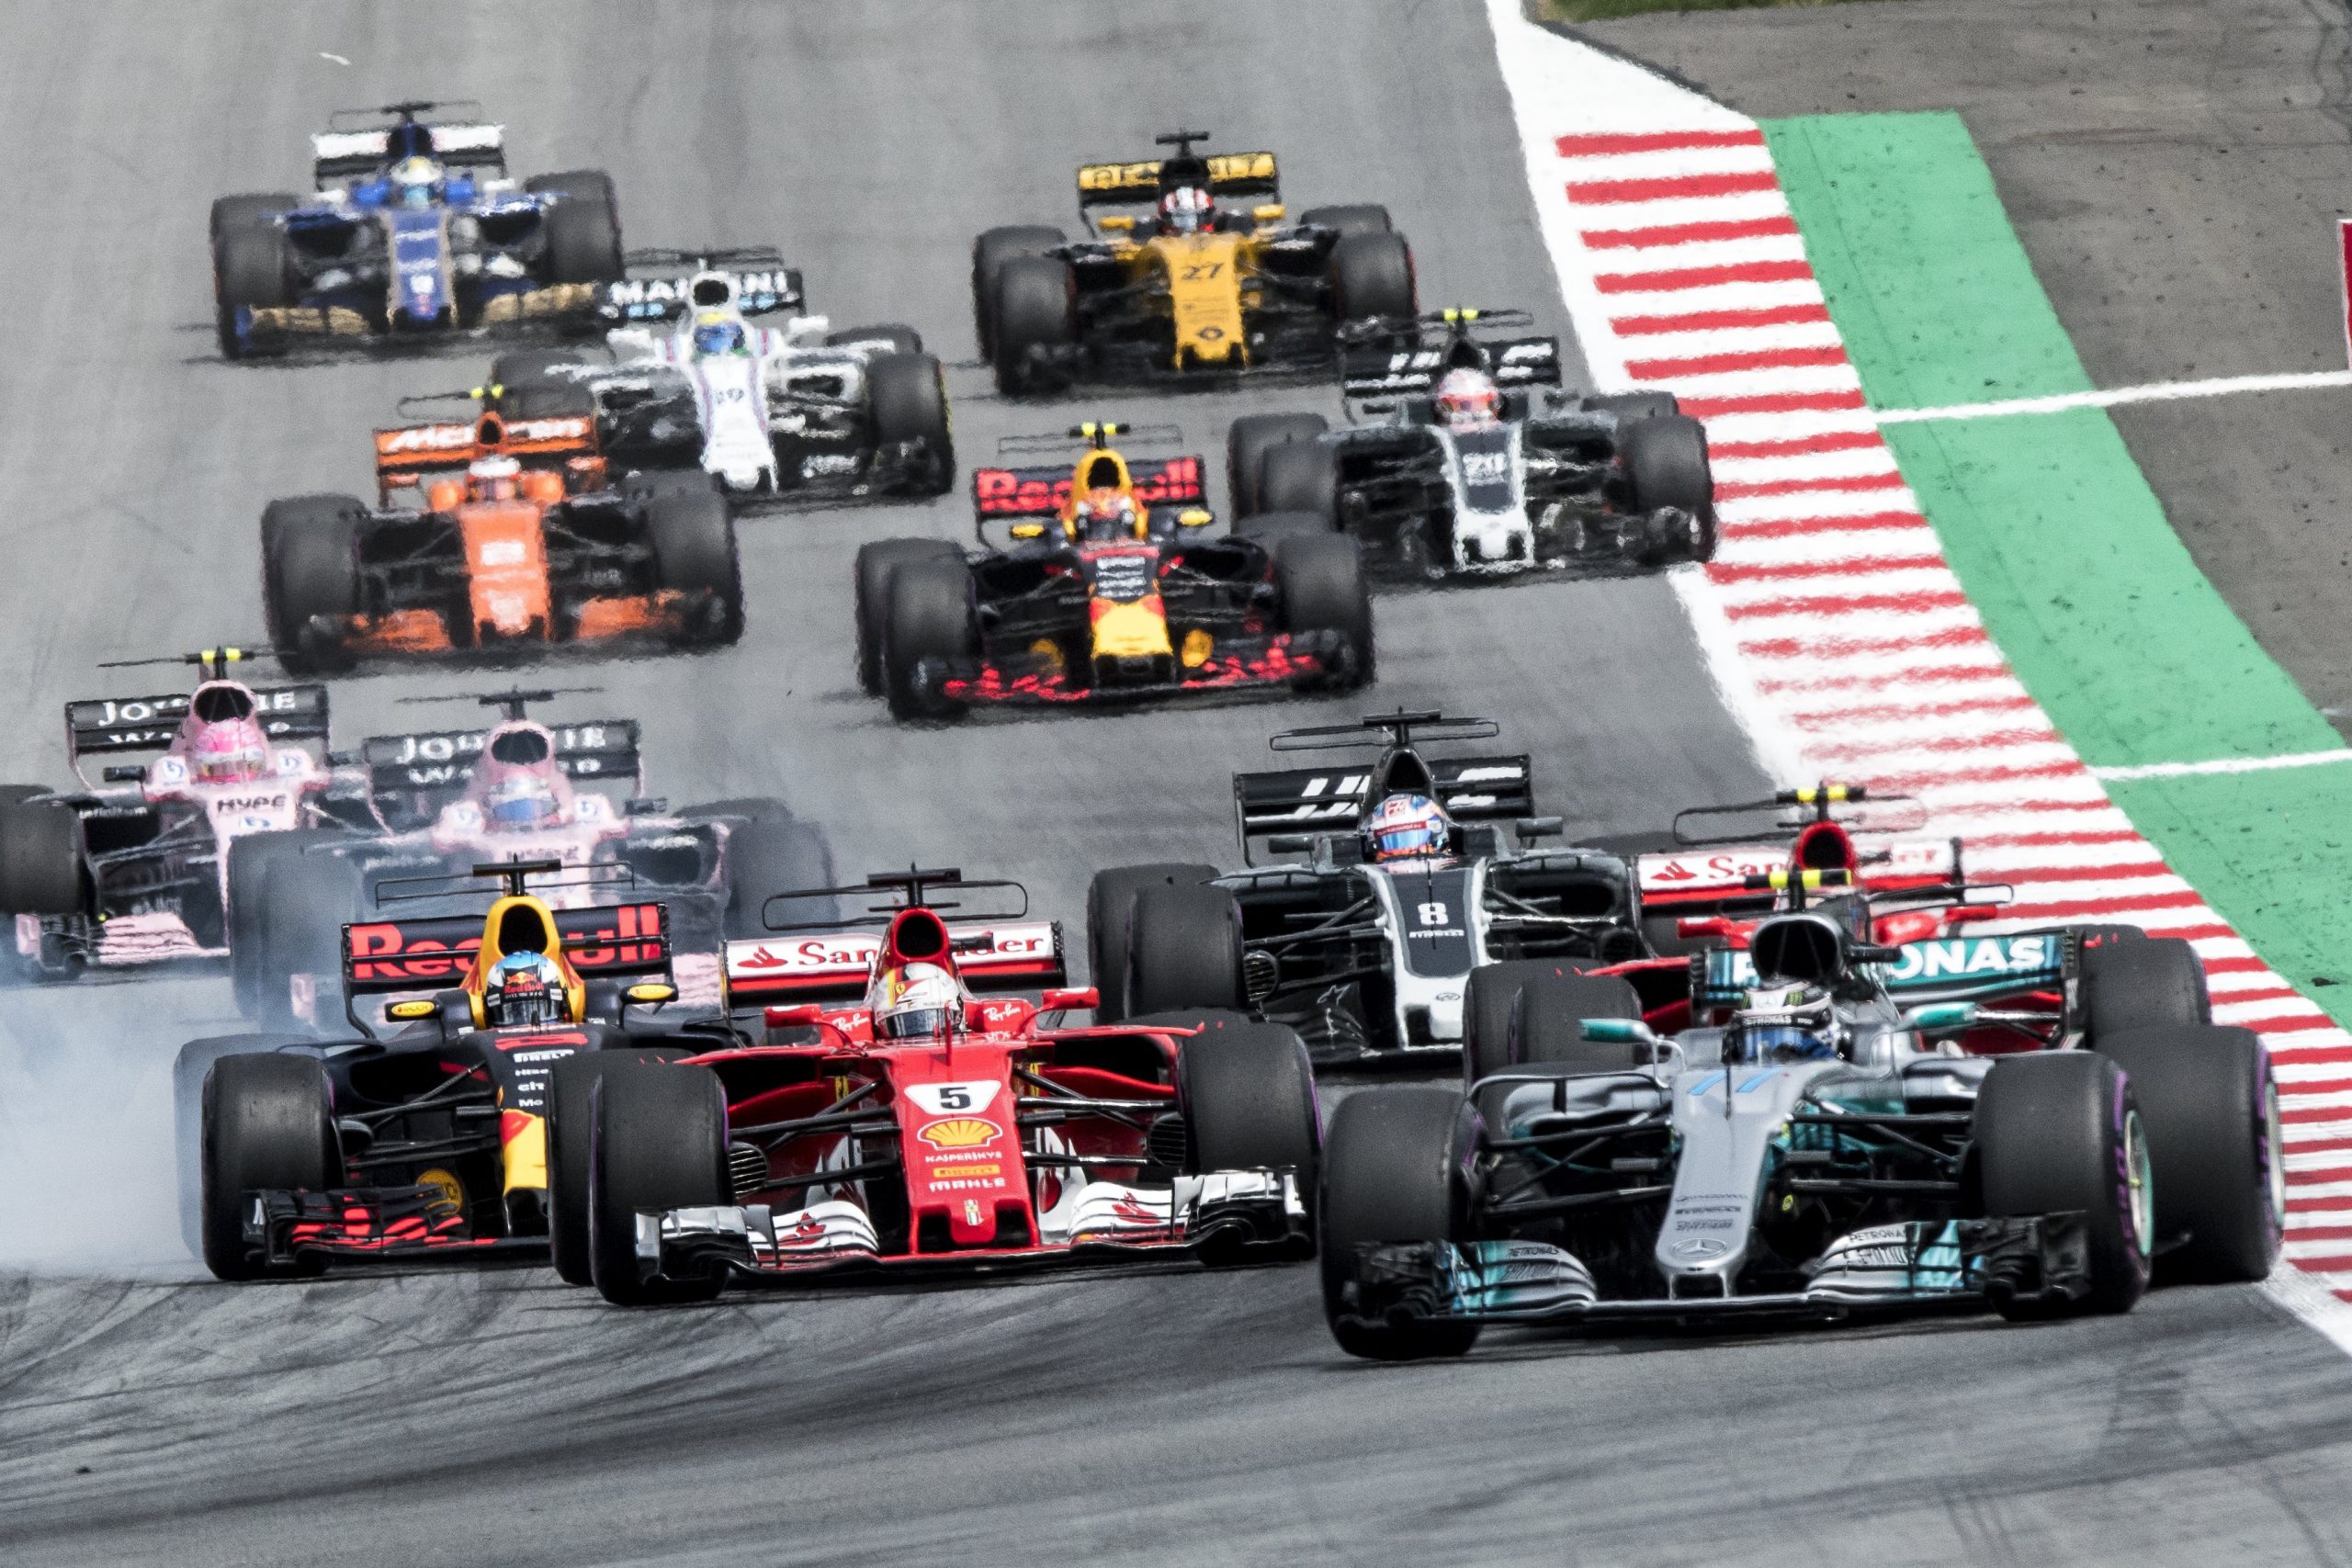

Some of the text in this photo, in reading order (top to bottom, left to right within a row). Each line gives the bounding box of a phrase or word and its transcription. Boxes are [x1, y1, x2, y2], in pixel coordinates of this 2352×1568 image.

[1181, 263, 1224, 279] 27
[217, 795, 287, 813] HYPE
[1418, 903, 1449, 926] 8
[940, 1087, 971, 1110] 5
[929, 1177, 1006, 1192] MAHLE
